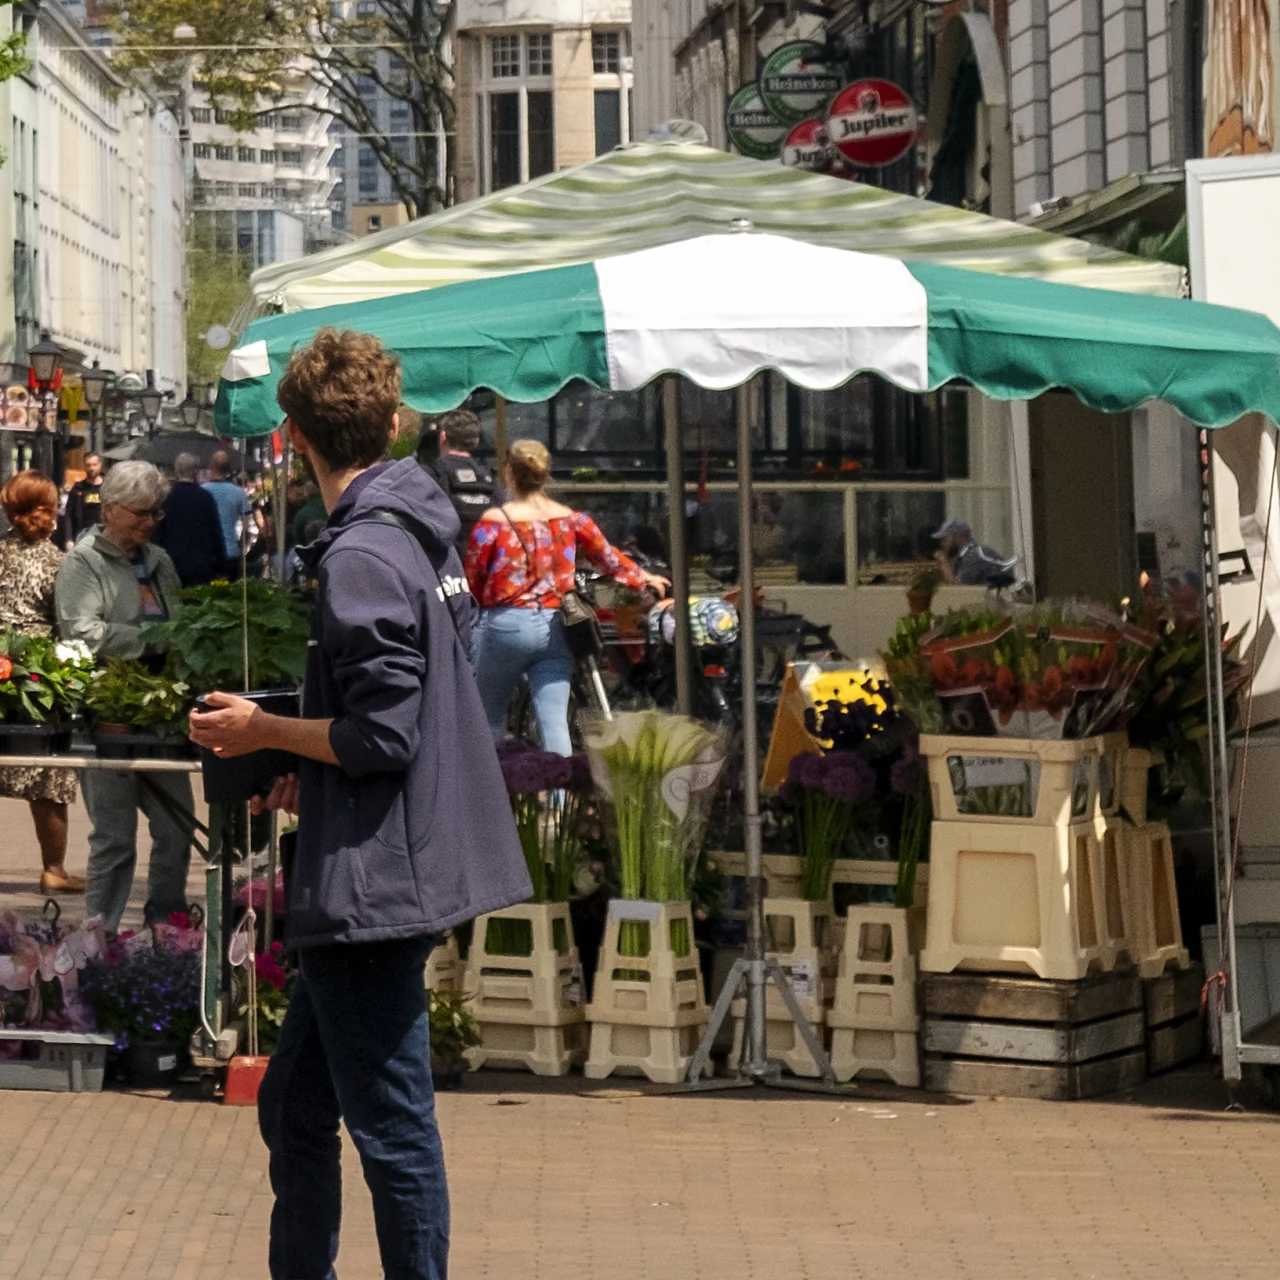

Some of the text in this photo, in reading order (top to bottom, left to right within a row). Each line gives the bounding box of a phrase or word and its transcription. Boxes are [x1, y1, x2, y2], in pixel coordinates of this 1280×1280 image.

[767, 78, 838, 91] Heineken
[733, 113, 777, 126] Heine
[844, 112, 909, 137] Jupiler
